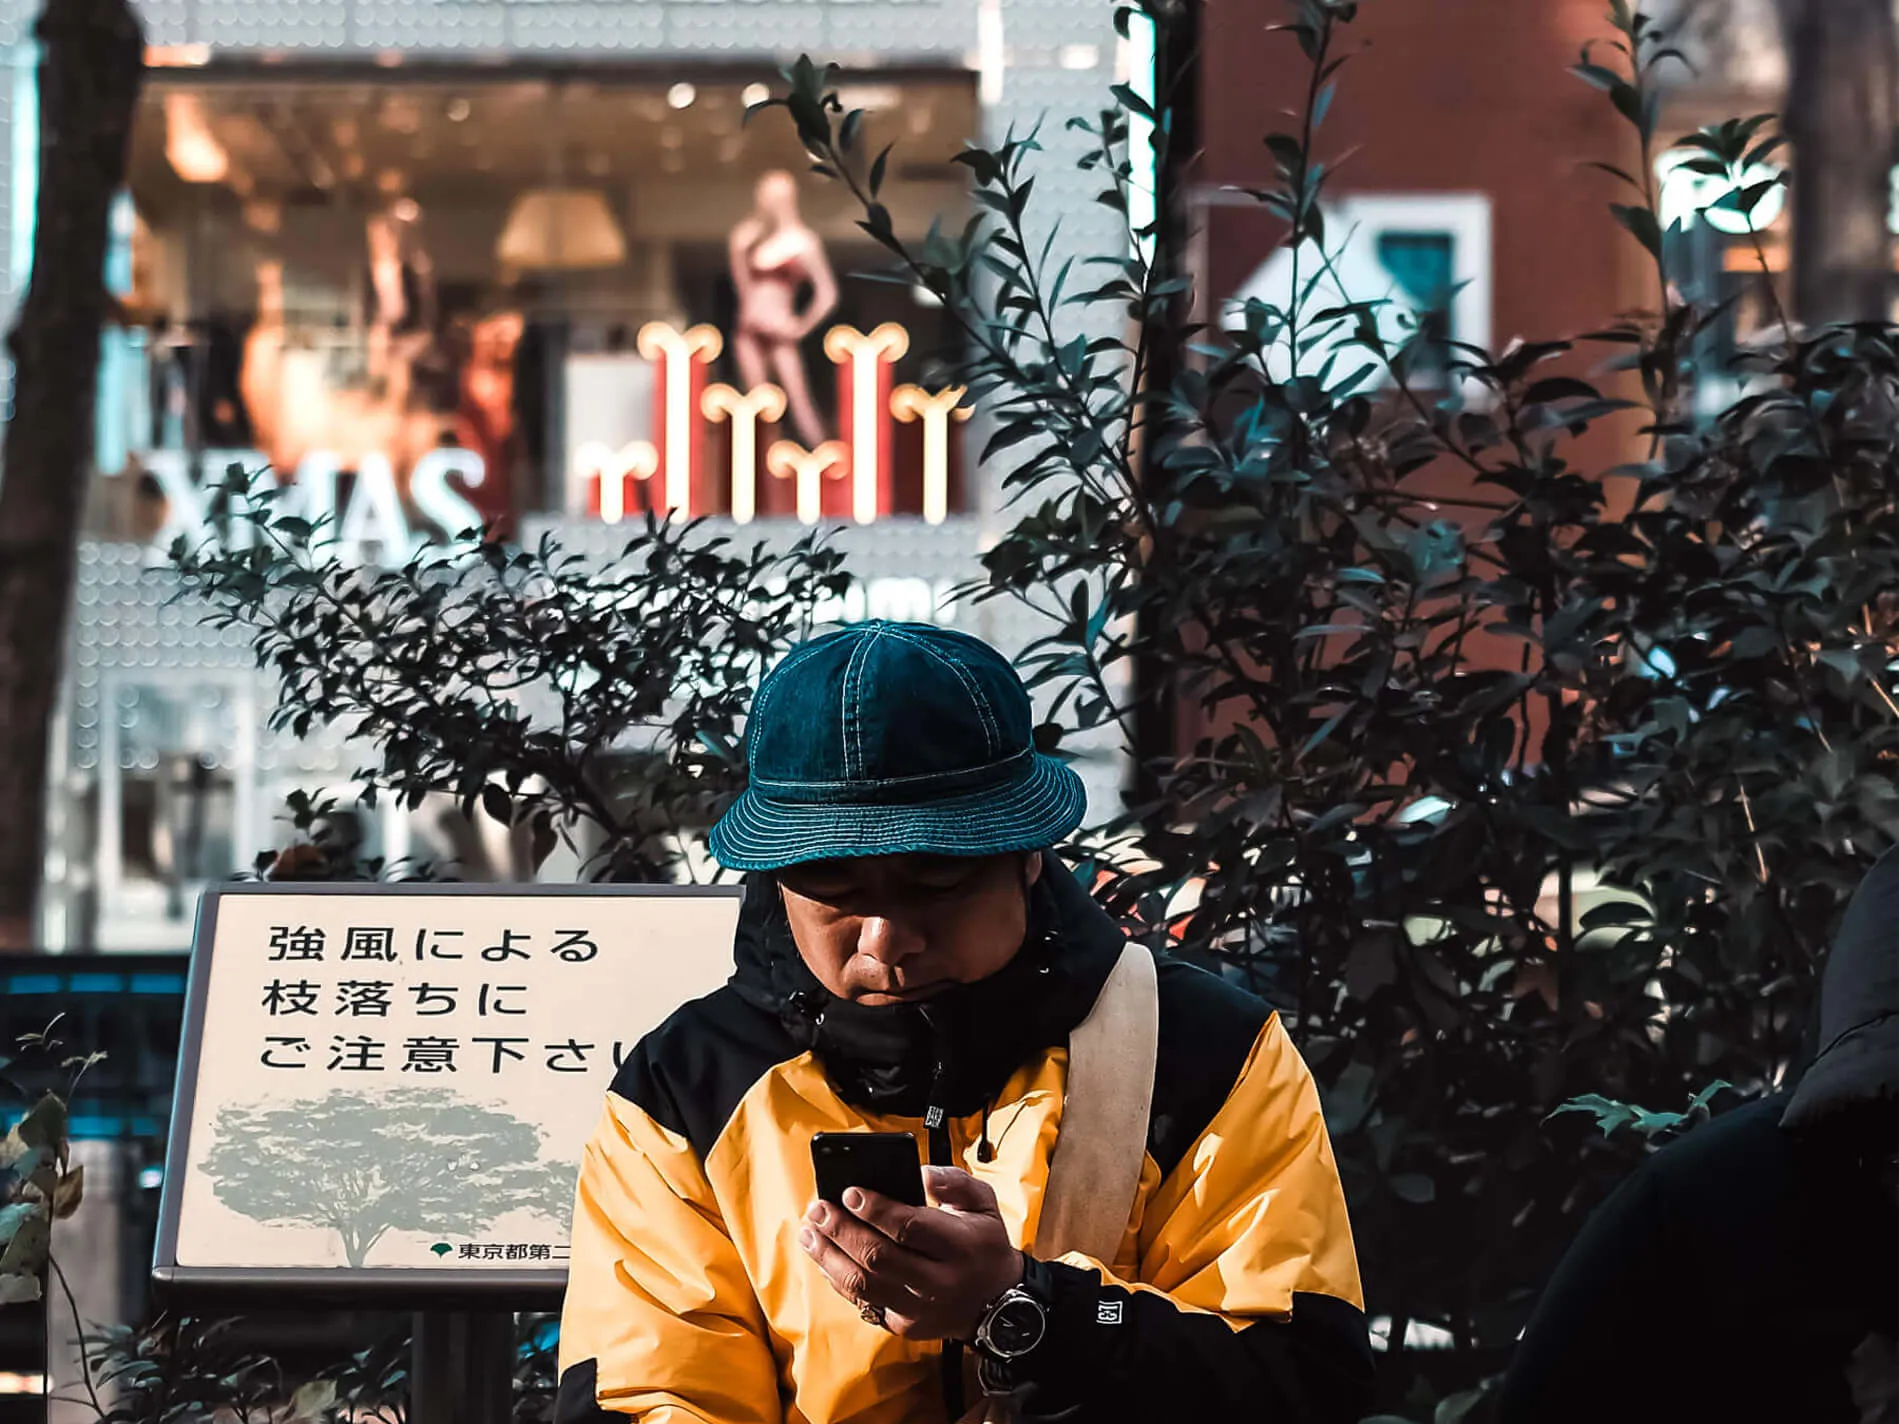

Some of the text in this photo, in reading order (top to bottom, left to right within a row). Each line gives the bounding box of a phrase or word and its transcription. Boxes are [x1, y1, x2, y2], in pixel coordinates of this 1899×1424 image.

[269, 926, 597, 962] 強風による
[262, 980, 527, 1016] 枝落ちに
[458, 1243, 571, 1260] 東京都第二
